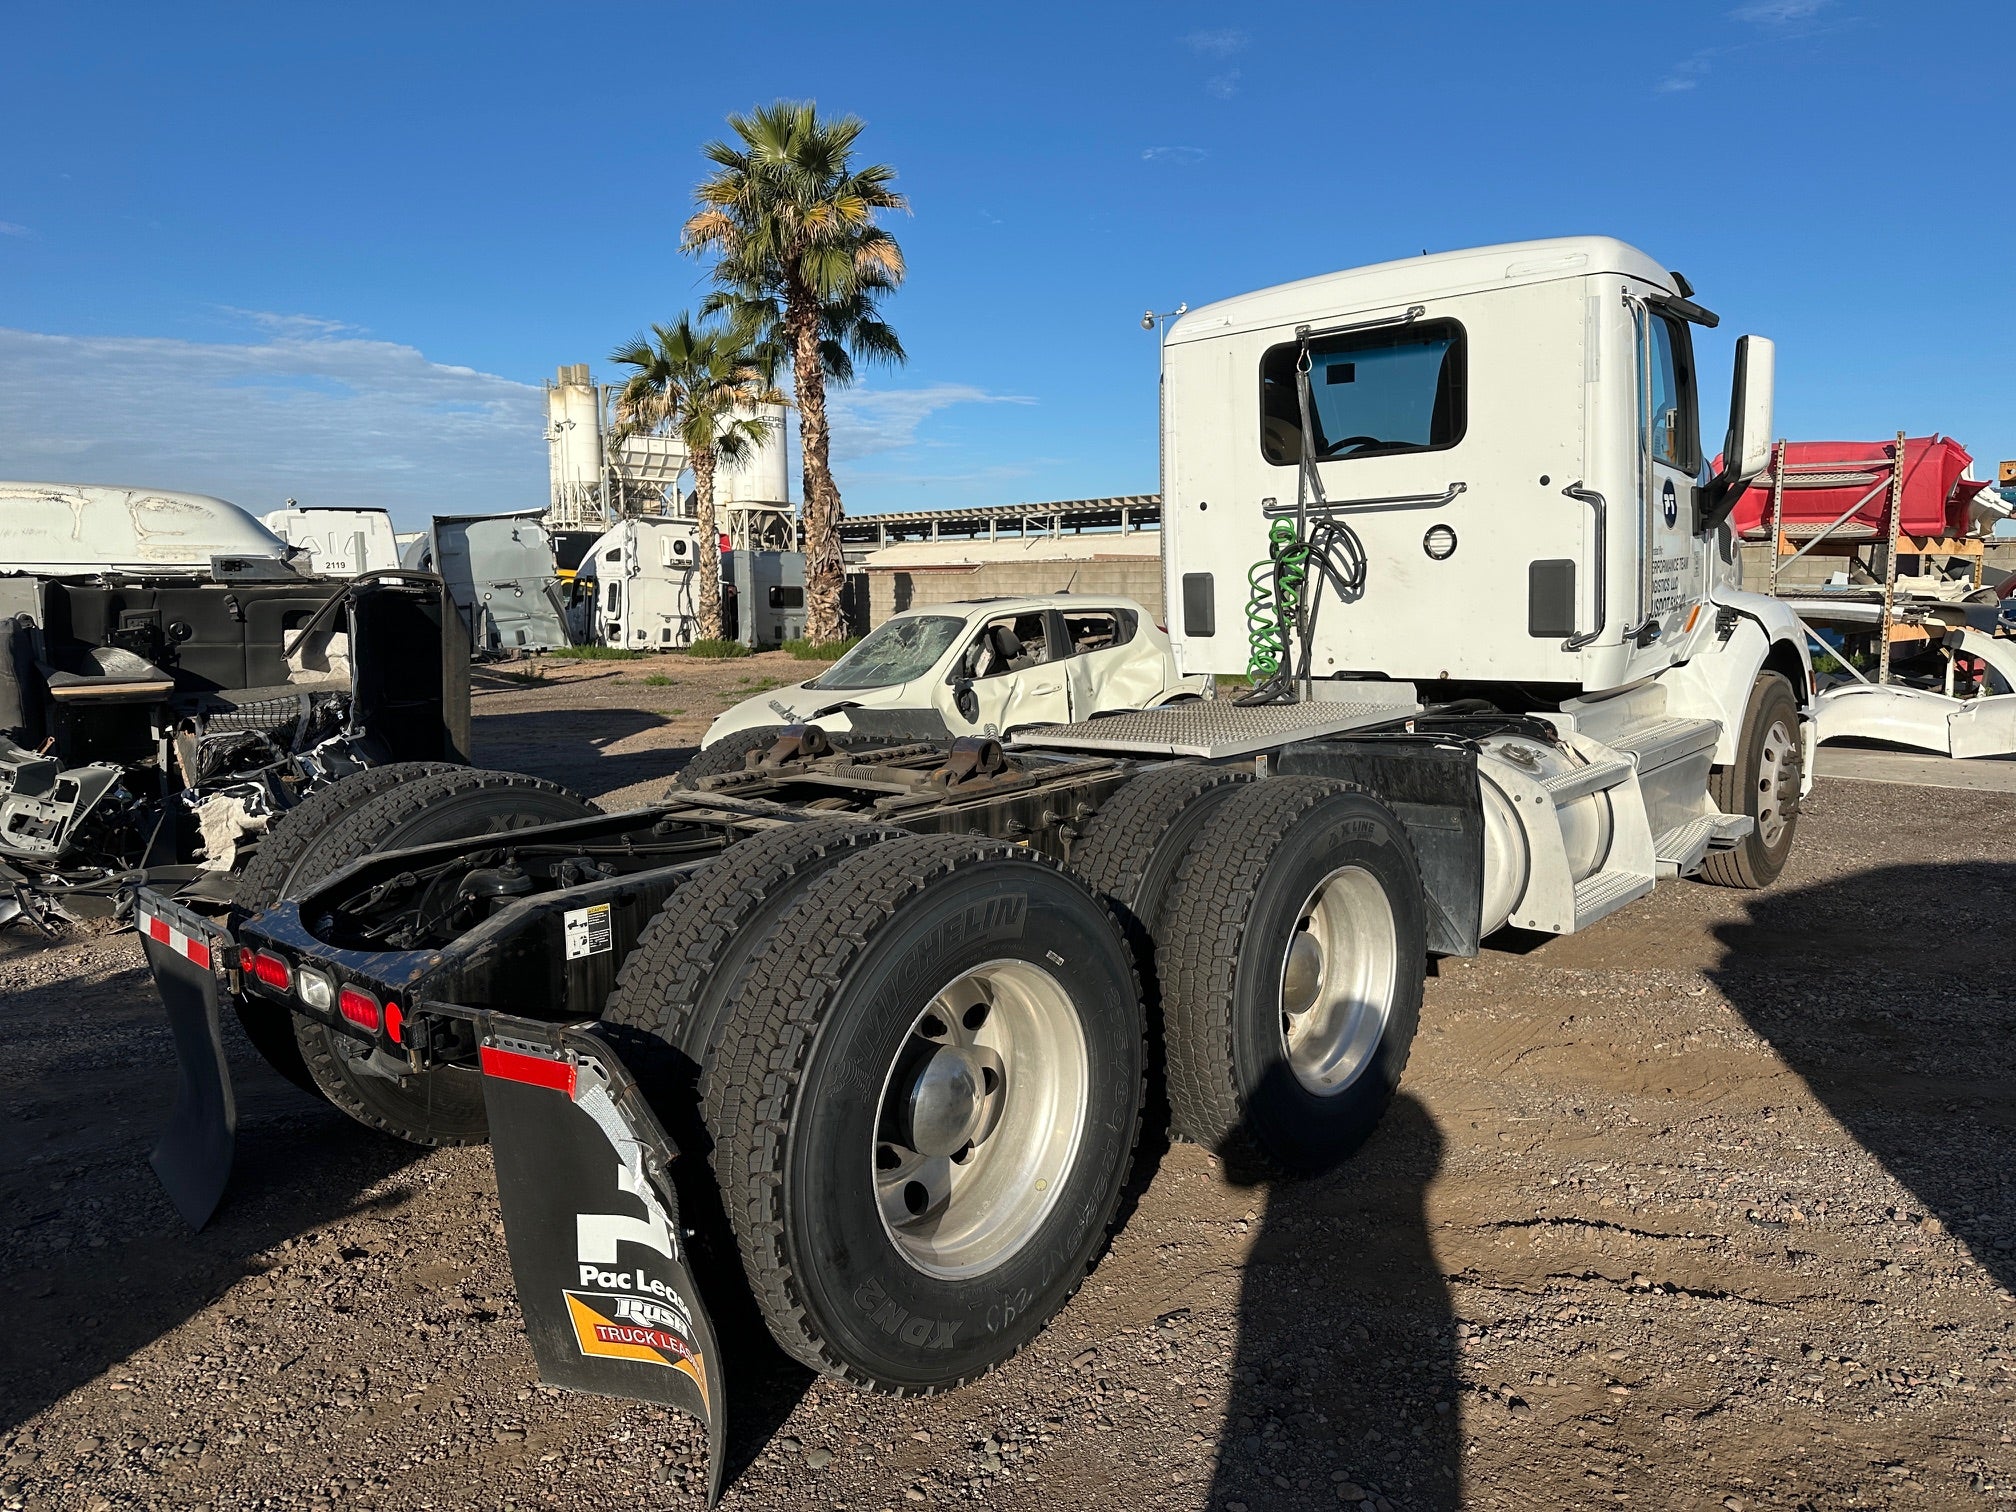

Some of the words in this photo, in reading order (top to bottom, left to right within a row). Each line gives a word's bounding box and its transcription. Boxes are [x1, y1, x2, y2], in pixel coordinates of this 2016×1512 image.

[325, 561, 346, 569] 2119
[1651, 558, 1679, 575] ERFORMANCE
[1352, 821, 1376, 834] LINE
[852, 894, 1026, 1062] MICHELIN
[579, 1265, 632, 1289] Pac
[636, 1269, 693, 1326] Lease
[852, 1276, 967, 1349] XDN2
[596, 1326, 658, 1346] TRUCK
